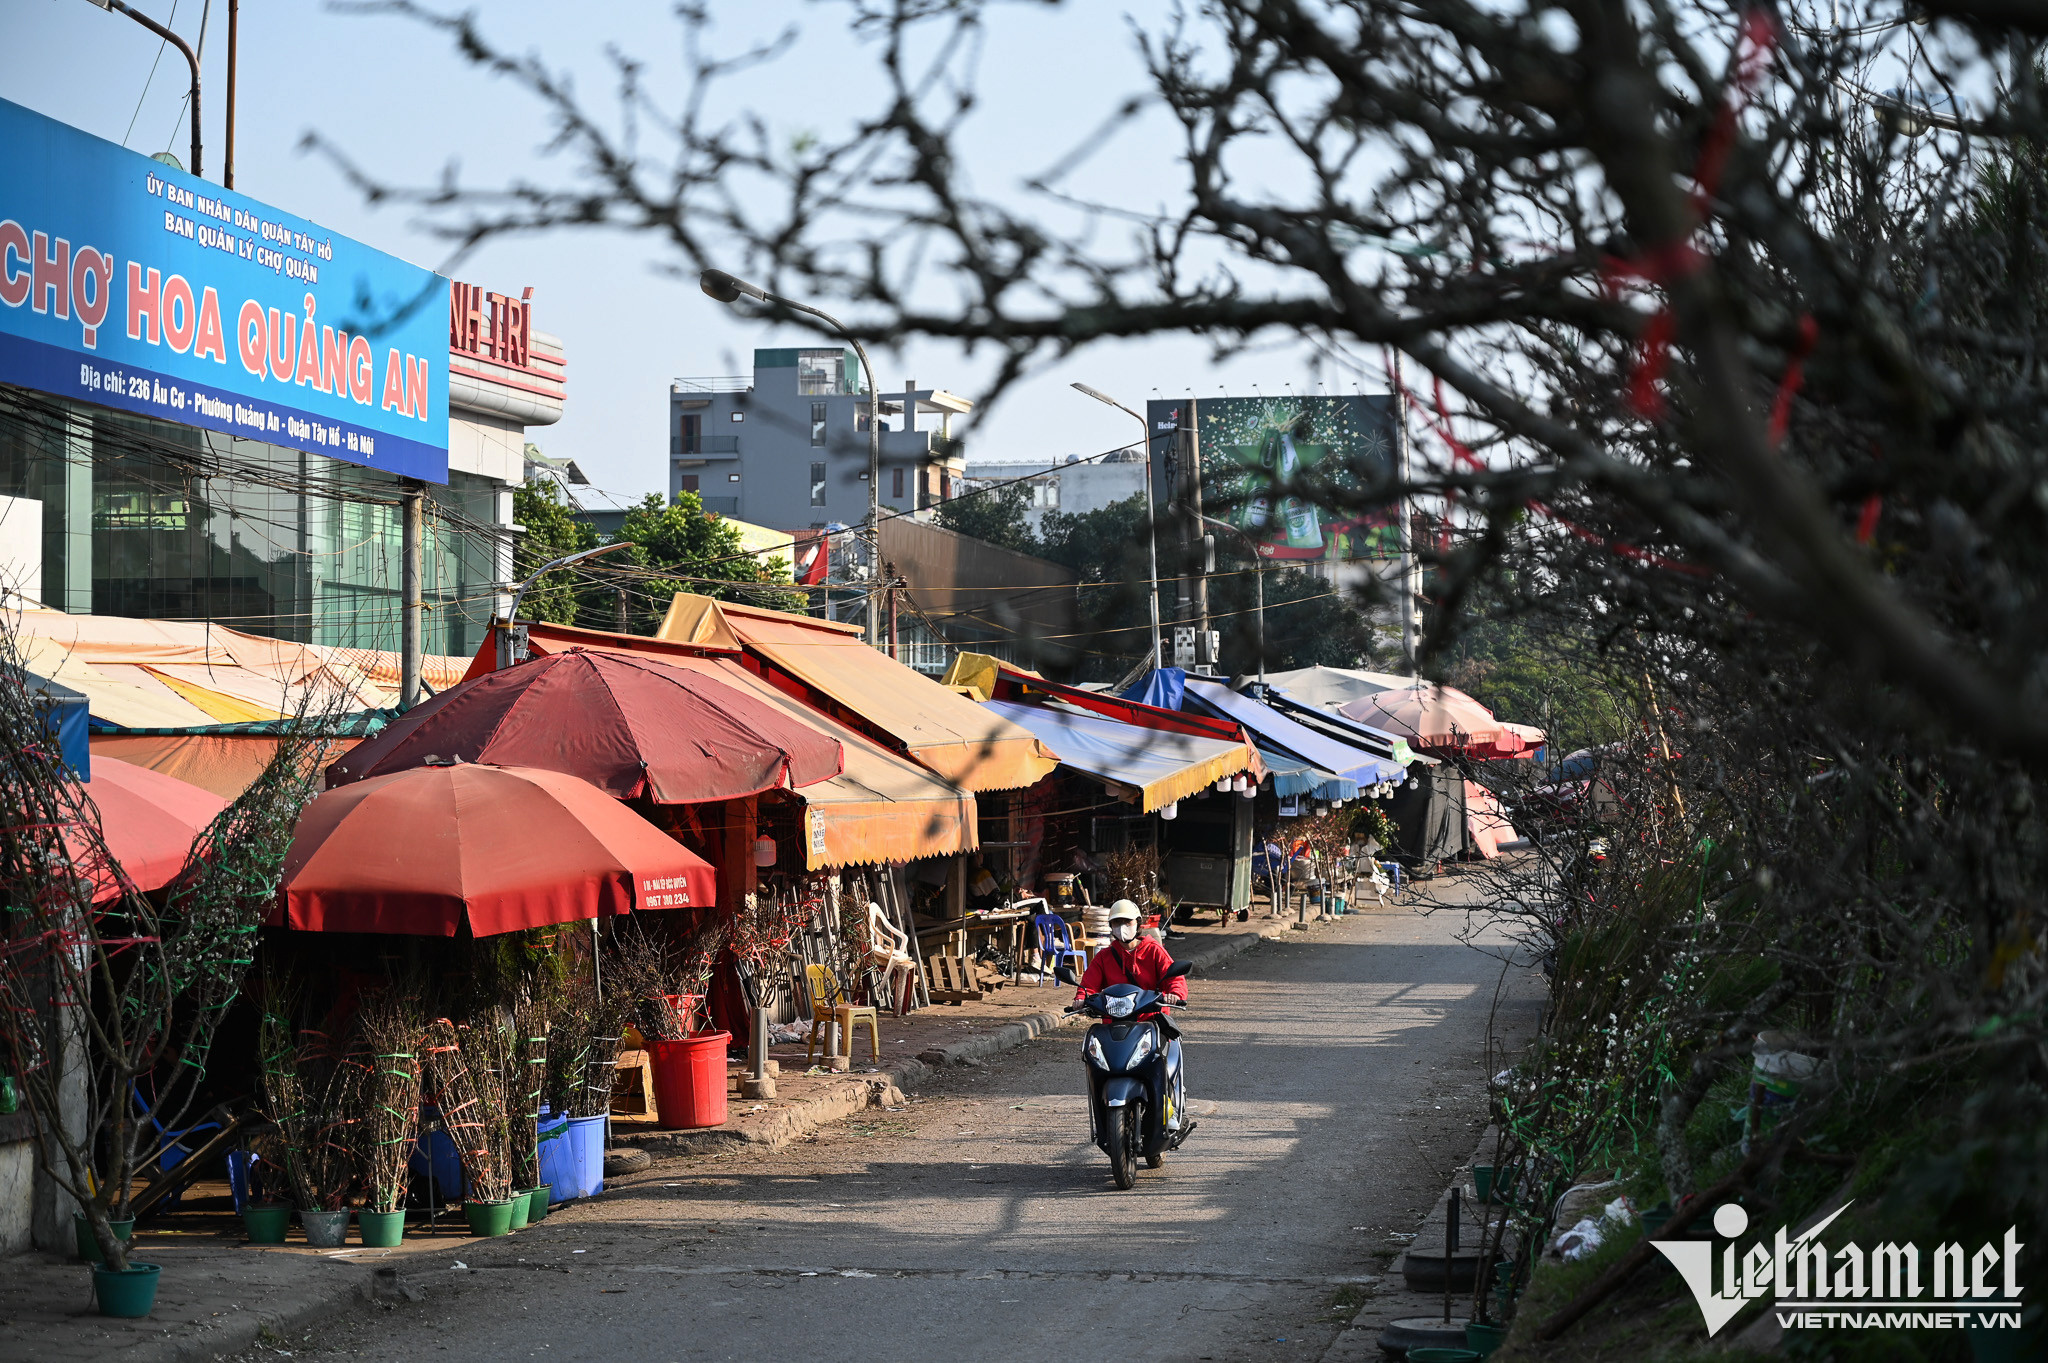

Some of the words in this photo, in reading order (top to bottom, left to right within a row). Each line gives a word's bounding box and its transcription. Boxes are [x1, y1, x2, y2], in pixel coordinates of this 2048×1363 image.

[164, 210, 194, 239] BAN
[198, 224, 235, 254] QUẢN
[238, 238, 254, 261] LÝ
[257, 246, 283, 275] CHỢ
[285, 256, 318, 285] QUẬN
[167, 182, 194, 209] BAN
[197, 195, 231, 223] NHÂN
[234, 209, 259, 234] DÂN
[261, 220, 292, 247] QUẬN
[293, 231, 315, 255] TÂY
[317, 237, 333, 262] HỒ
[0, 219, 113, 350] CHỢ
[127, 260, 227, 364] HOA
[237, 292, 373, 406] QUẢNG
[382, 348, 429, 422] AN
[486, 286, 534, 368] TRÍ
[80, 363, 101, 392] Địa
[104, 370, 126, 395] chỉ:
[128, 376, 151, 401] 236
[153, 378, 168, 405] Âu
[170, 386, 186, 409] Cơ
[194, 392, 233, 424] Phường
[235, 403, 265, 431] Quảng
[267, 411, 280, 432] An
[288, 416, 311, 442] Quận
[312, 422, 328, 446] Tây
[328, 425, 341, 447] Hồ
[347, 432, 359, 451] Hà
[360, 435, 375, 458] Nội
[1157, 421, 1178, 430] Hein
[674, 893, 690, 904] 234
